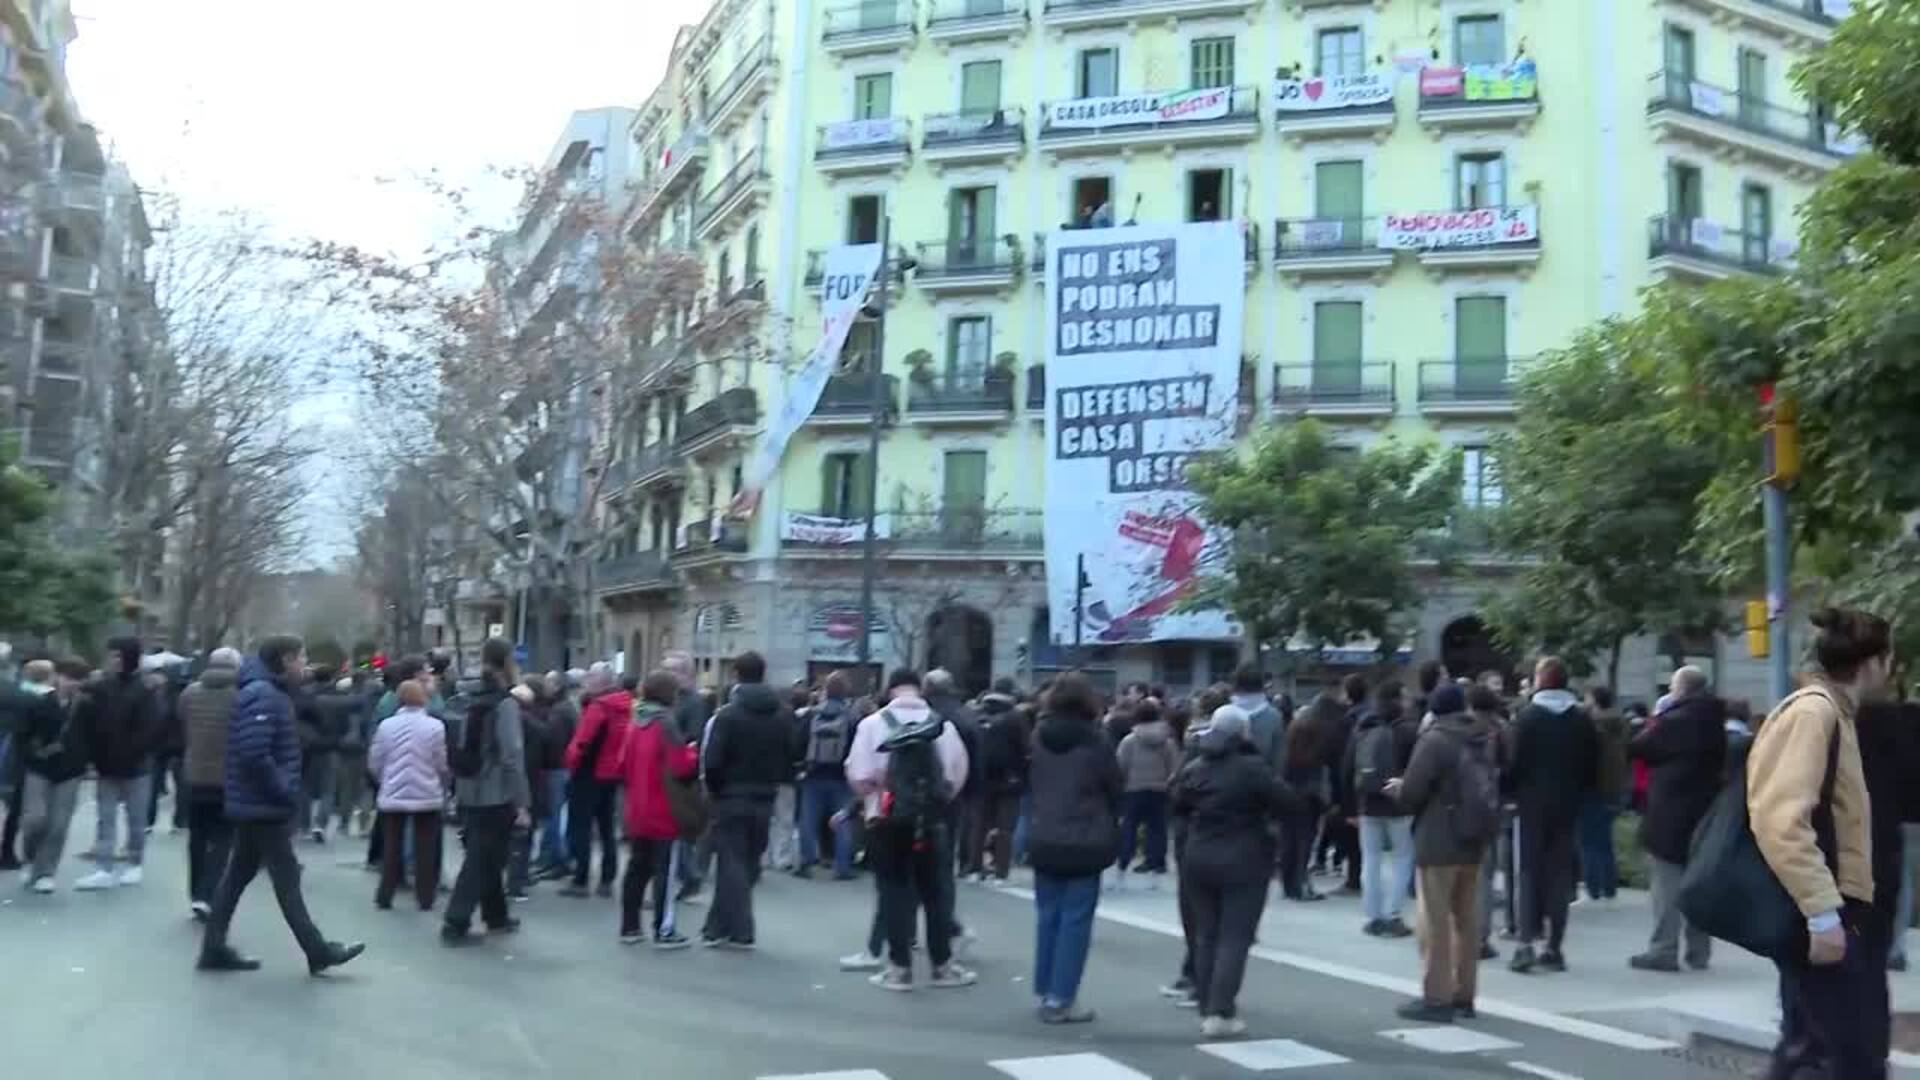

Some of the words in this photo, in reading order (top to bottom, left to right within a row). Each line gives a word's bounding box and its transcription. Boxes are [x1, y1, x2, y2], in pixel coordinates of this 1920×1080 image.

[1055, 102, 1096, 121] CASA
[1062, 251, 1099, 279] NO
[1107, 246, 1161, 276] ENS
[1062, 278, 1176, 313] PODRAN
[1062, 311, 1215, 350] DESNONAR
[1062, 381, 1205, 419] DEFENSEM
[1061, 422, 1136, 455] CASA
